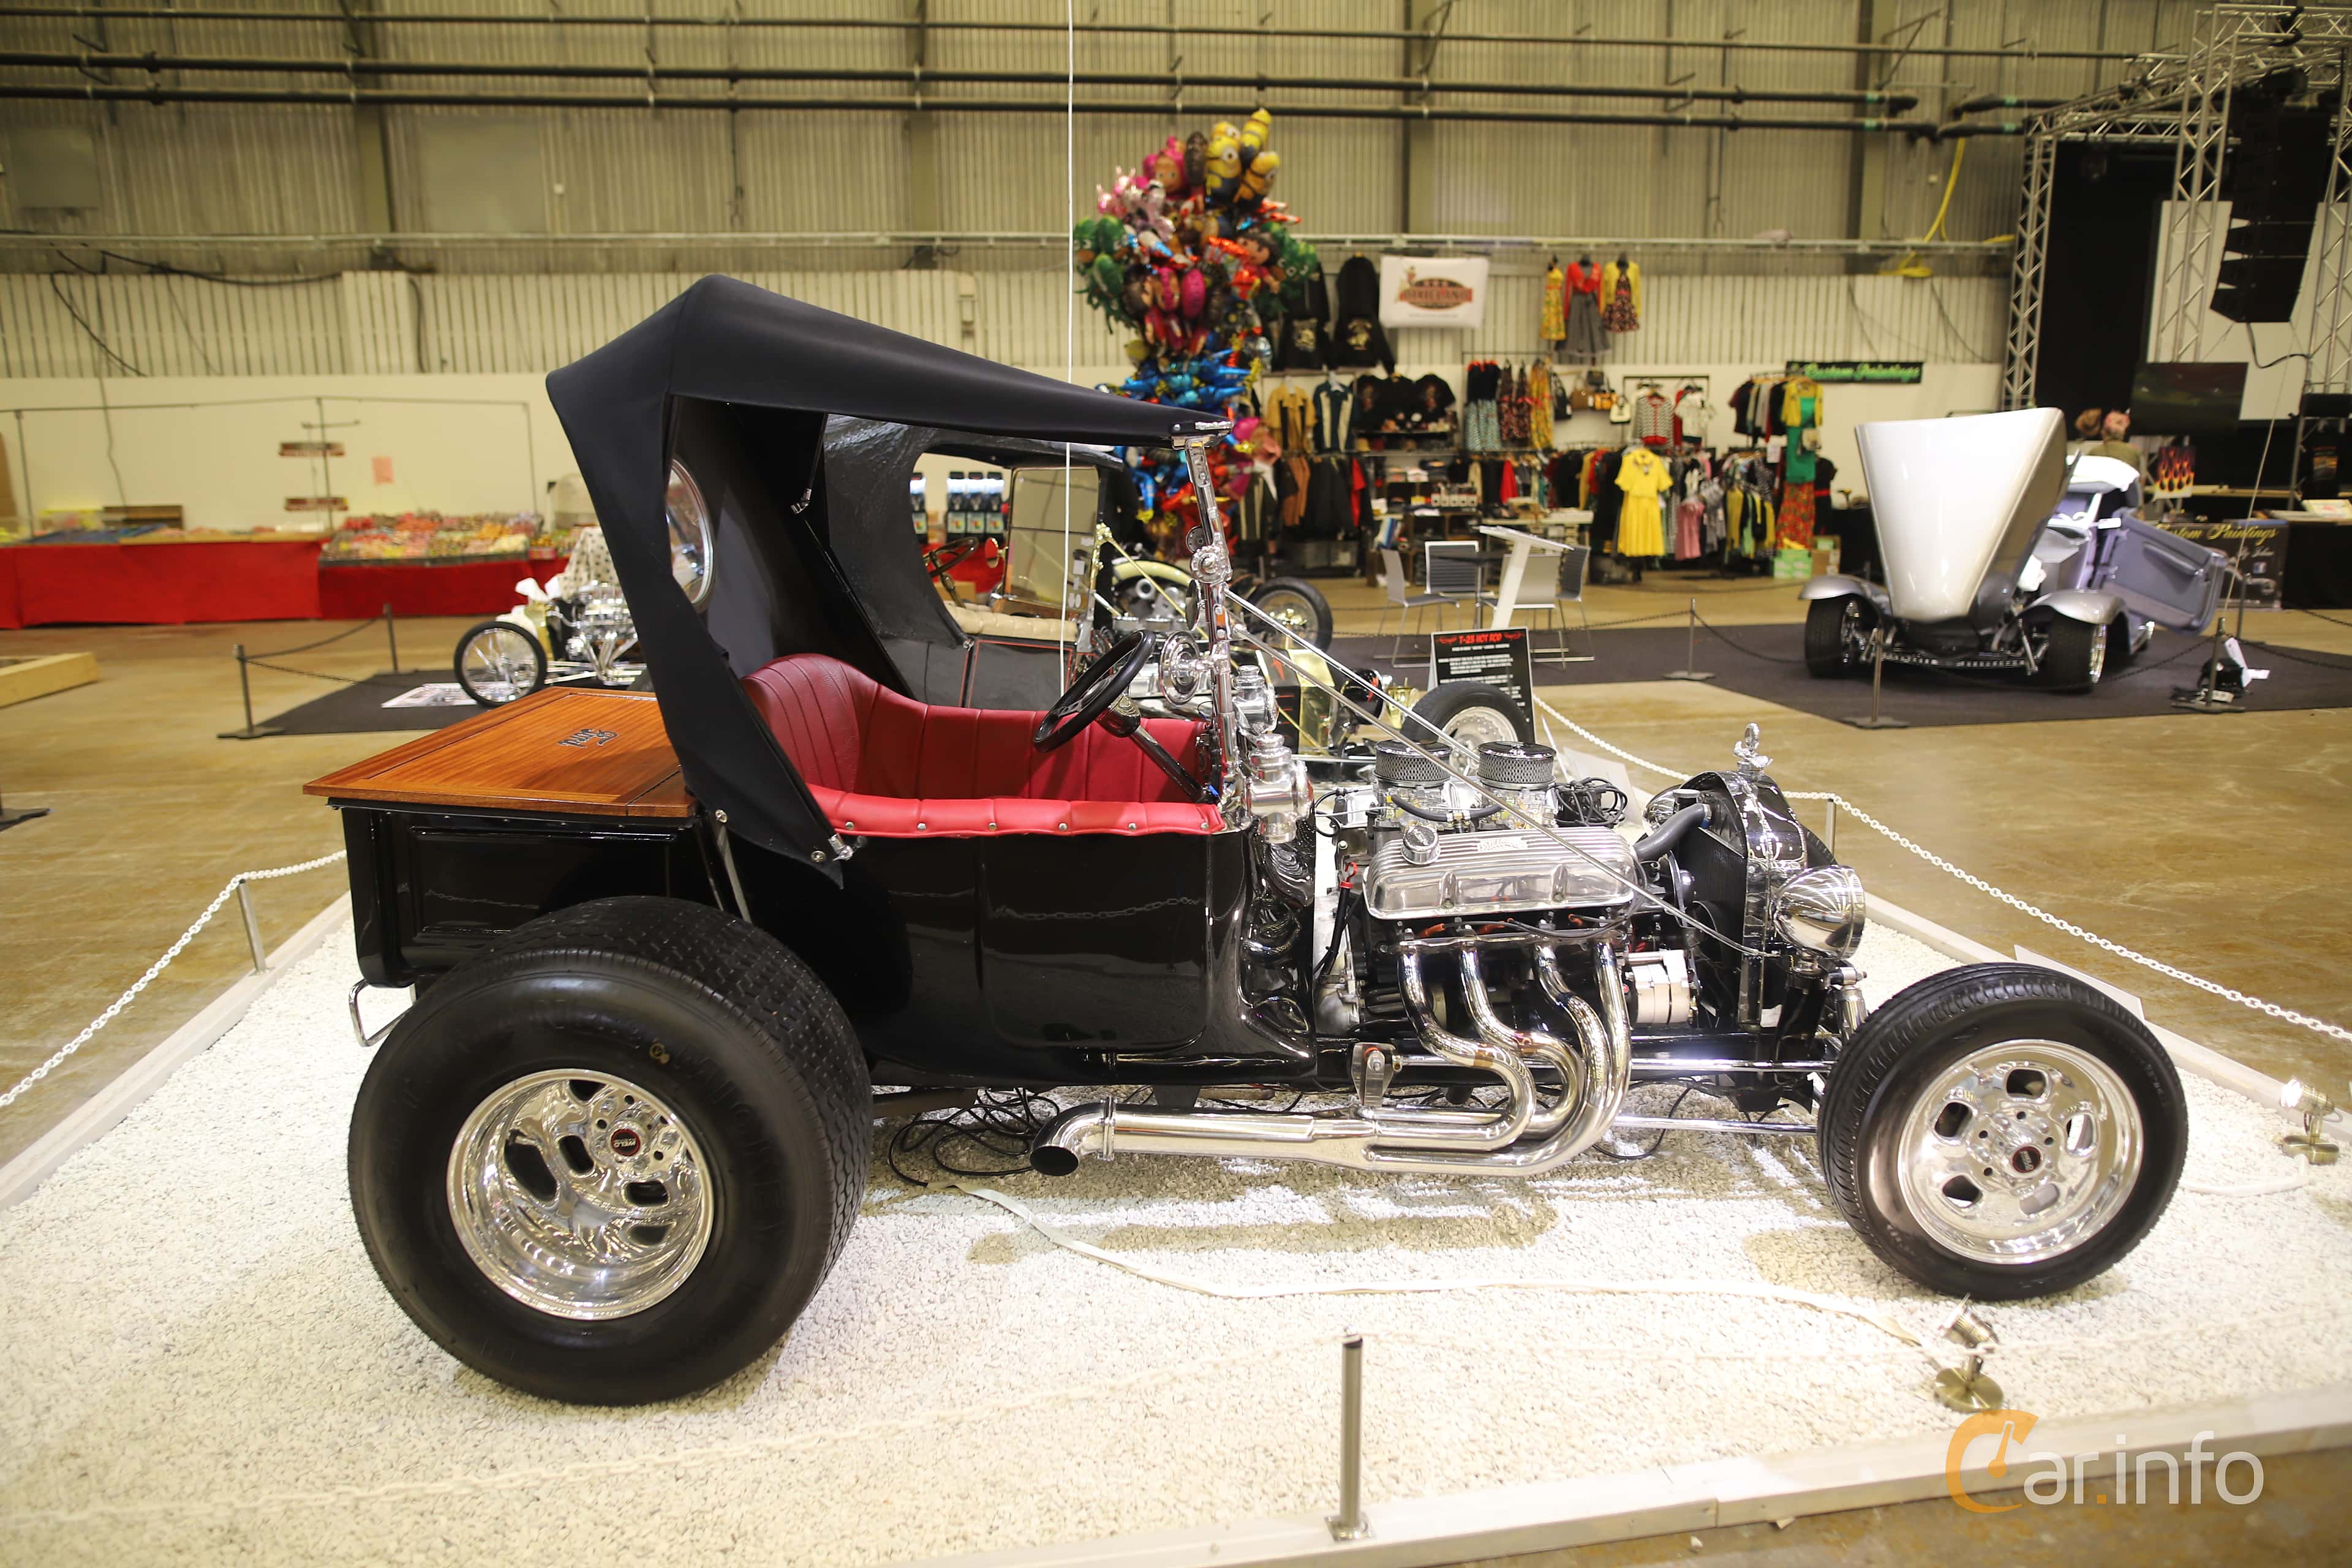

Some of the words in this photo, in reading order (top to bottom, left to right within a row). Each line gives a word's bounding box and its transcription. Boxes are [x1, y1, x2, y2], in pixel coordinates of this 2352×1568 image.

[2156, 523, 2203, 540] ustom
[2207, 523, 2278, 546] Paintings
[1476, 634, 1488, 643] HOT
[1489, 633, 1502, 643] ROD
[557, 729, 618, 748] Ford
